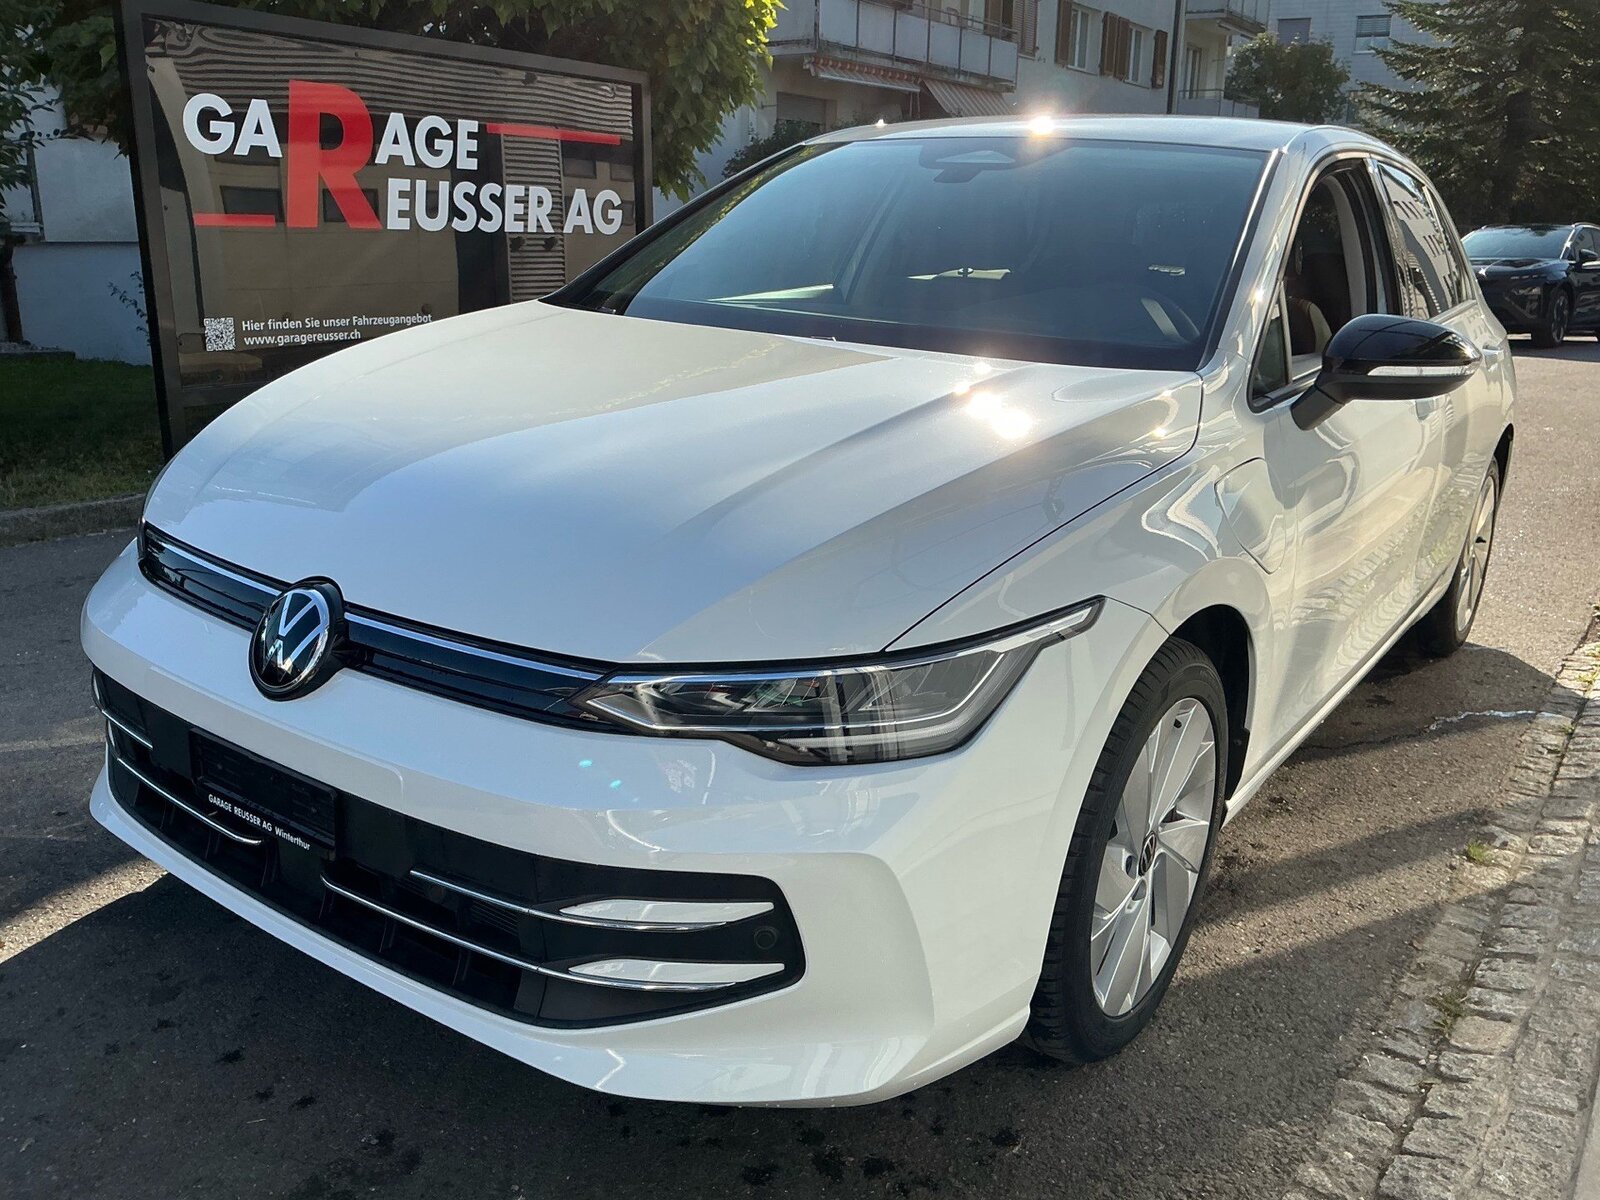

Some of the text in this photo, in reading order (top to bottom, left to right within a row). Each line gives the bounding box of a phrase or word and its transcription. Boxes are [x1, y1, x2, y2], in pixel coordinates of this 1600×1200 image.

[182, 79, 479, 230] GARAGE
[563, 189, 624, 236] AG
[242, 313, 433, 331] Hier finden Sie unser Fahrzeugangebot
[244, 330, 361, 345] www.garagereusser.ch
[208, 794, 311, 850] GARAGE REUSSER AG Winterthur
